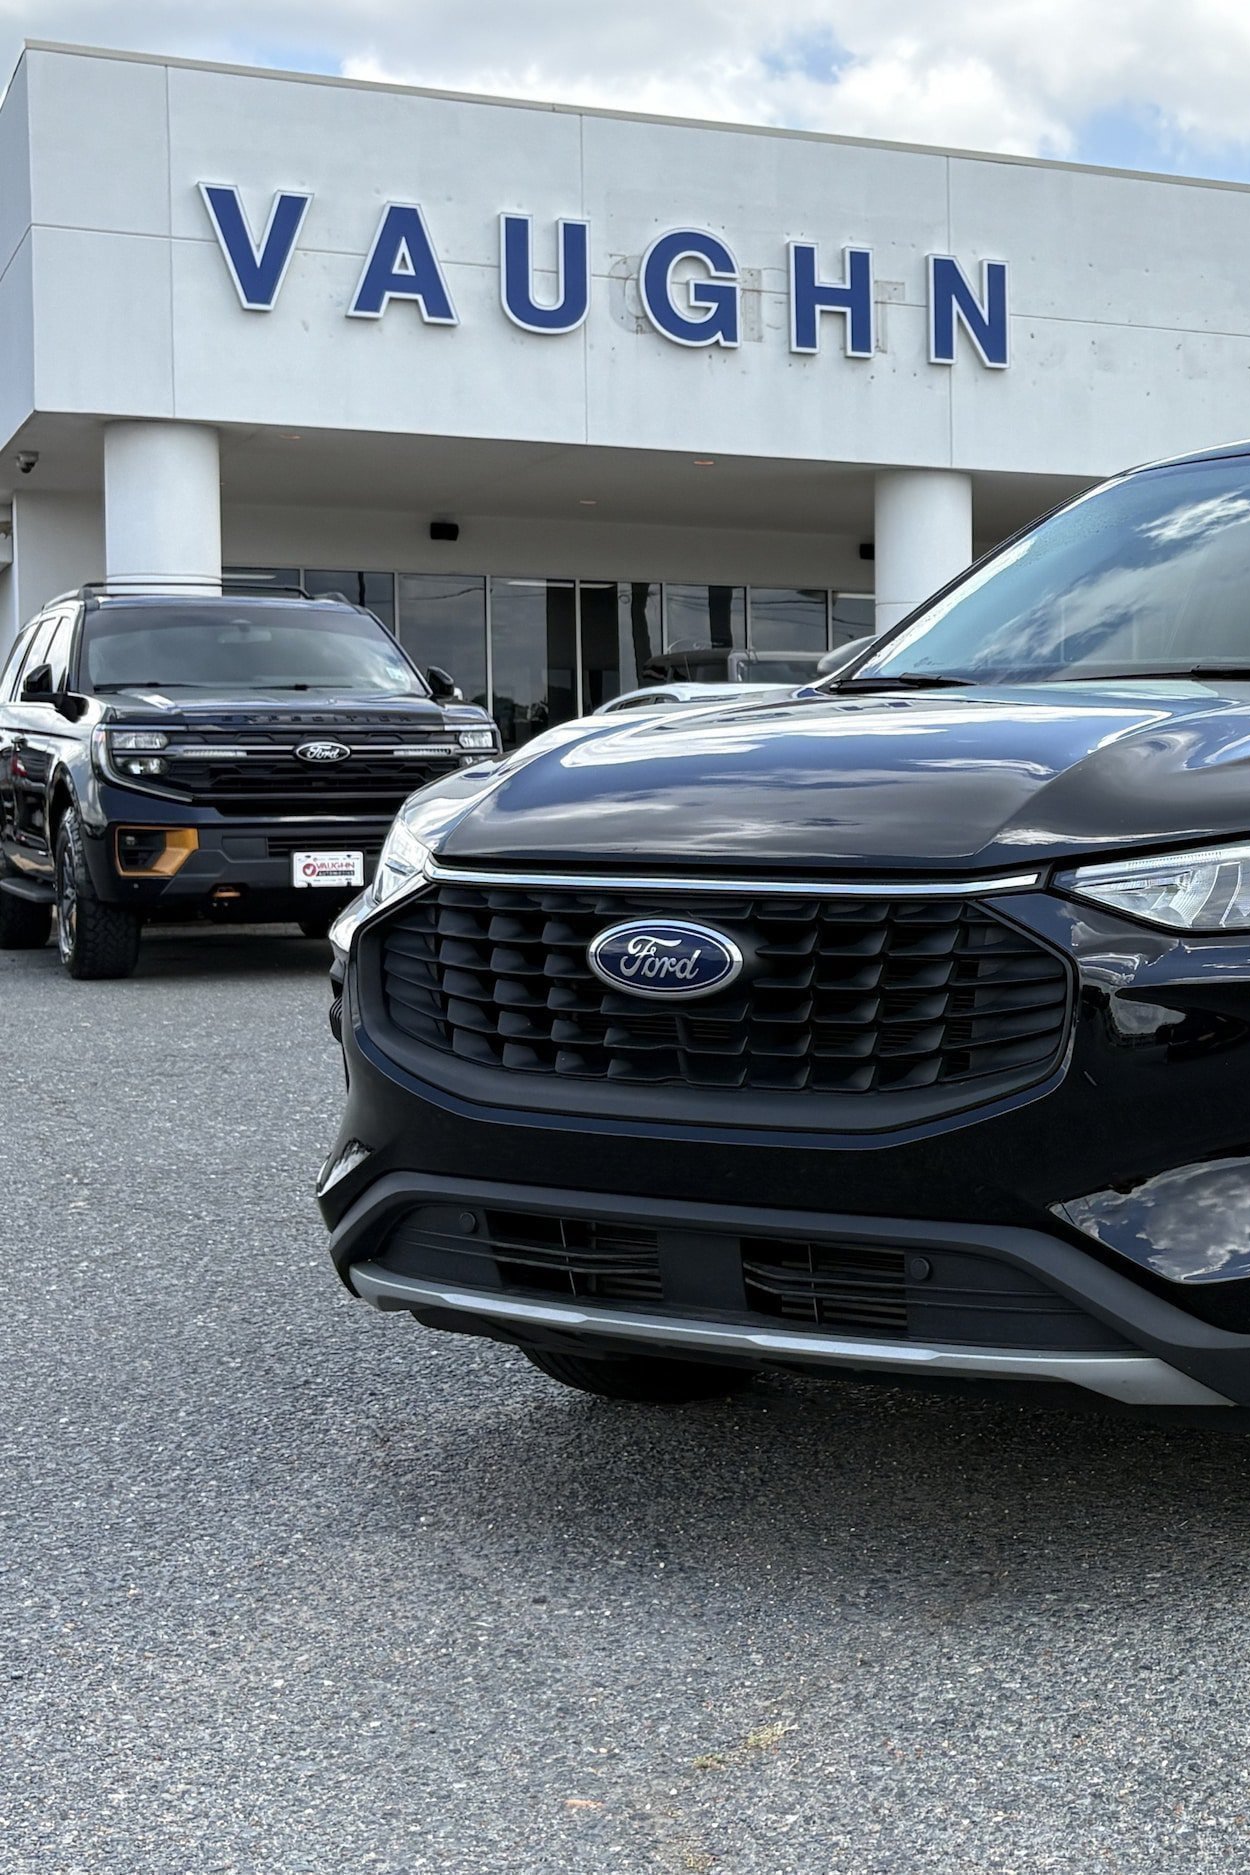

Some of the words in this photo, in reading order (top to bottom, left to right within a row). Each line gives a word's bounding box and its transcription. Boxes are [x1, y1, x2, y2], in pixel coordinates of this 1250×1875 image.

[197, 181, 1010, 369] VAUGHN
[306, 745, 340, 759] Ford
[316, 861, 355, 869] VAUGHN
[619, 935, 702, 980] Ford
